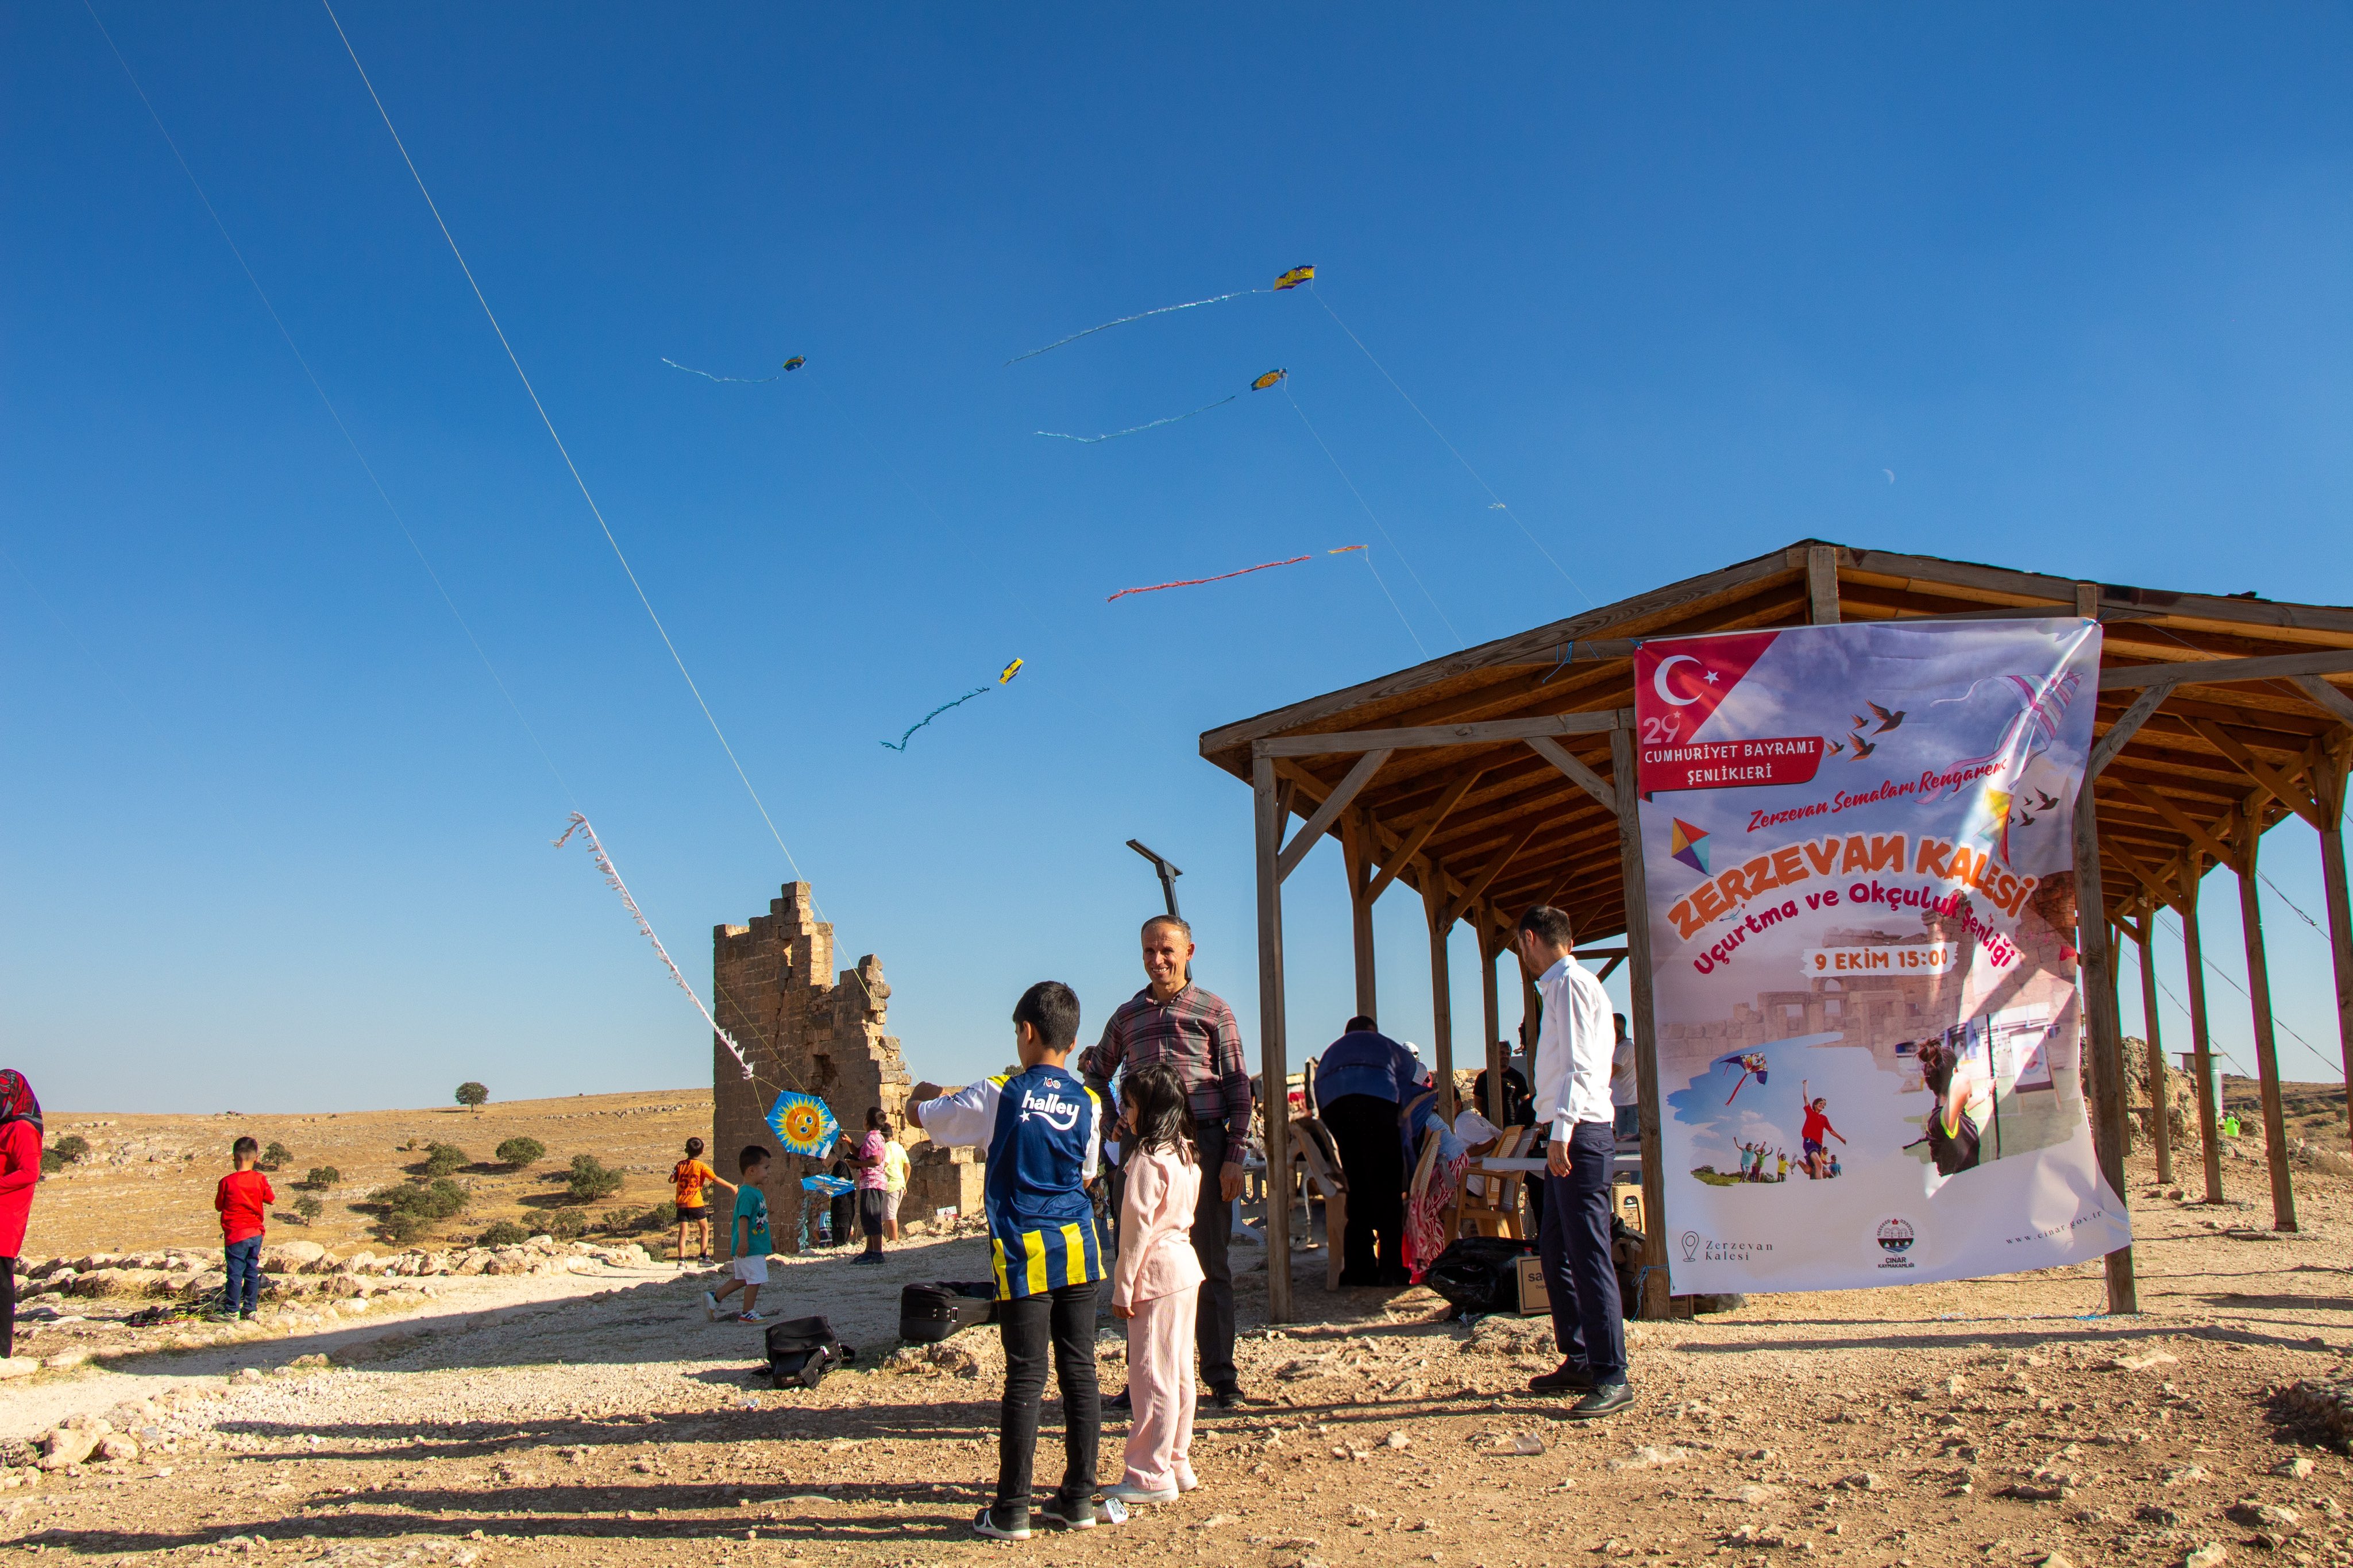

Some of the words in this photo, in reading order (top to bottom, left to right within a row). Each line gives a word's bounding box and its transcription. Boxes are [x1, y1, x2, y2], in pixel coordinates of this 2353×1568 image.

[1645, 744, 1738, 763] CUMHURİYET
[1745, 740, 1815, 756] BAYRAMI
[1687, 763, 1772, 785] ŞENLİKLERİ
[1747, 801, 1828, 833] Zerzevan
[1831, 780, 1916, 813] Semaları
[1918, 758, 2007, 794] Rengarenk
[1668, 835, 1907, 940] ZERZEVAN
[1916, 839, 2038, 918] KALESİ
[1693, 899, 1799, 975] Uçurtma
[1805, 889, 1839, 910] ve
[1849, 880, 1961, 919] Okçuluk
[1964, 906, 2016, 968] Şenliği
[1814, 953, 1827, 971] 9
[1835, 947, 1889, 970] EKİM
[1897, 948, 1948, 968] 15:00
[1021, 1090, 1080, 1122] halley
[679, 1173, 699, 1189] 53
[2005, 1210, 2103, 1244] www.cinar.gov.tr
[1706, 1240, 1773, 1251] Zerzevan
[1706, 1251, 1749, 1261] Kalesi
